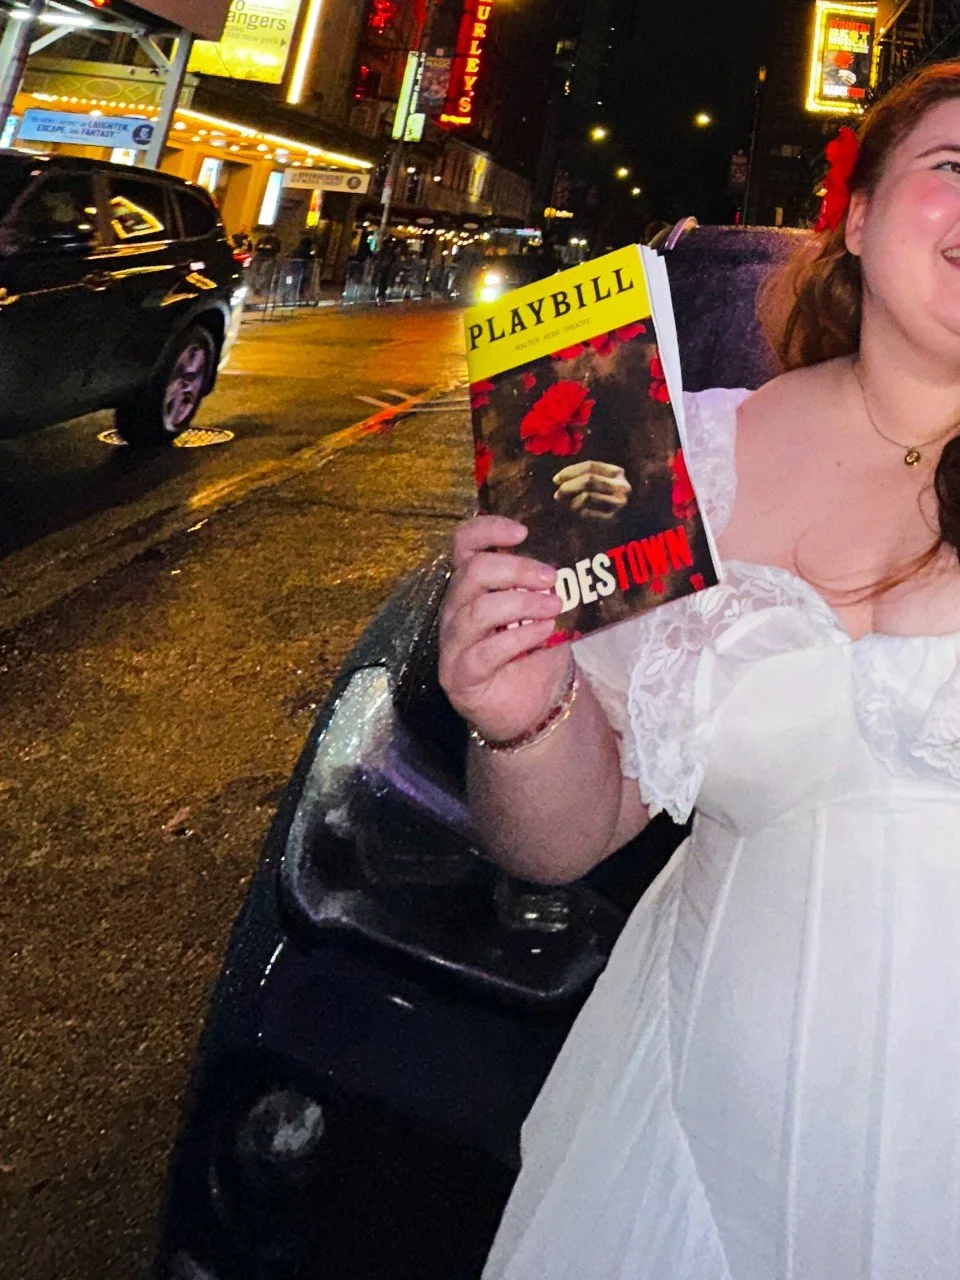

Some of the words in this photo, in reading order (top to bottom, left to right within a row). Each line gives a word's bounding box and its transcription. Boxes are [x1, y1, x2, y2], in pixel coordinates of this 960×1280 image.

[227, 10, 287, 31] angers
[468, 268, 634, 352] PLAYBILL
[515, 336, 540, 351] WALTER
[555, 525, 694, 613] DESTOWN
